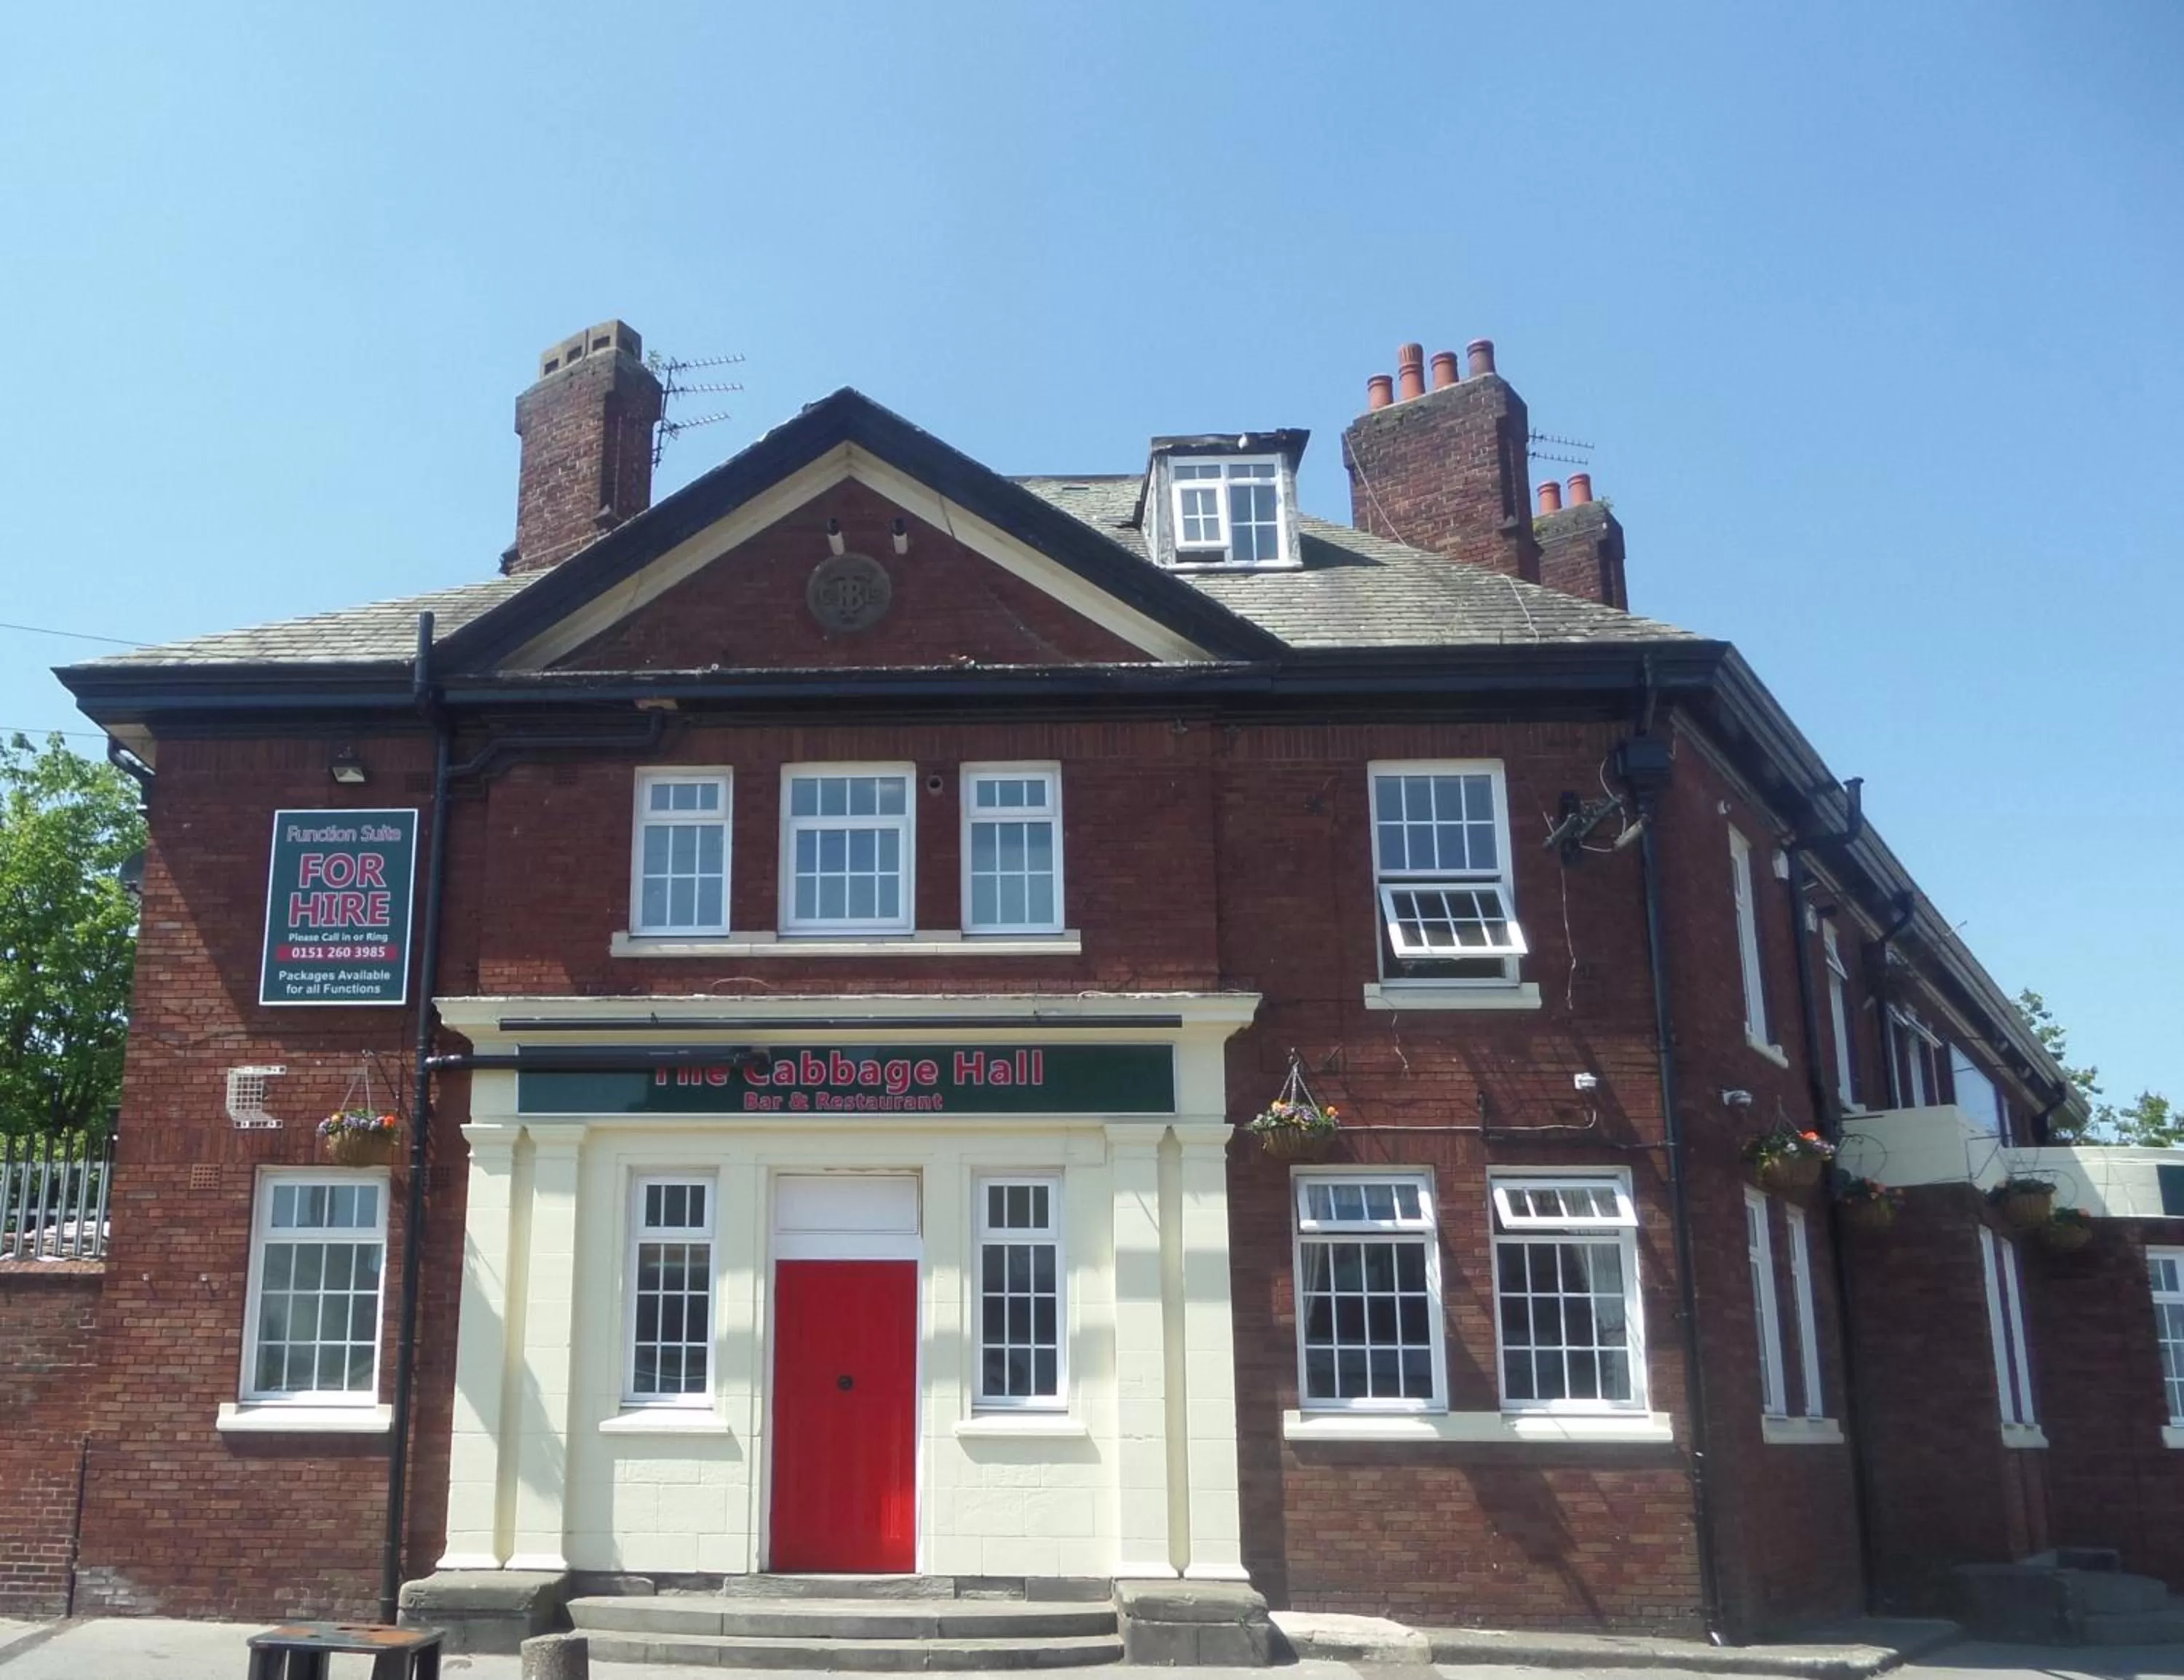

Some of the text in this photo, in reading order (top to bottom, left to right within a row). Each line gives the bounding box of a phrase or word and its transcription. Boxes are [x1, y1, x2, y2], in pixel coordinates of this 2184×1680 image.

[287, 824, 402, 842] Function Suite
[299, 852, 387, 888] FOR
[288, 892, 390, 927] HIRE
[288, 933, 319, 942] Please
[321, 932, 339, 941] Call
[341, 932, 350, 941] in
[366, 932, 388, 943] Ring
[292, 946, 386, 959] 0151 260 3985
[279, 970, 391, 982] Packages Available
[286, 983, 380, 994] for all Functions
[954, 1049, 1043, 1085] Hall
[743, 1091, 943, 1111] Bar & Restaurant
